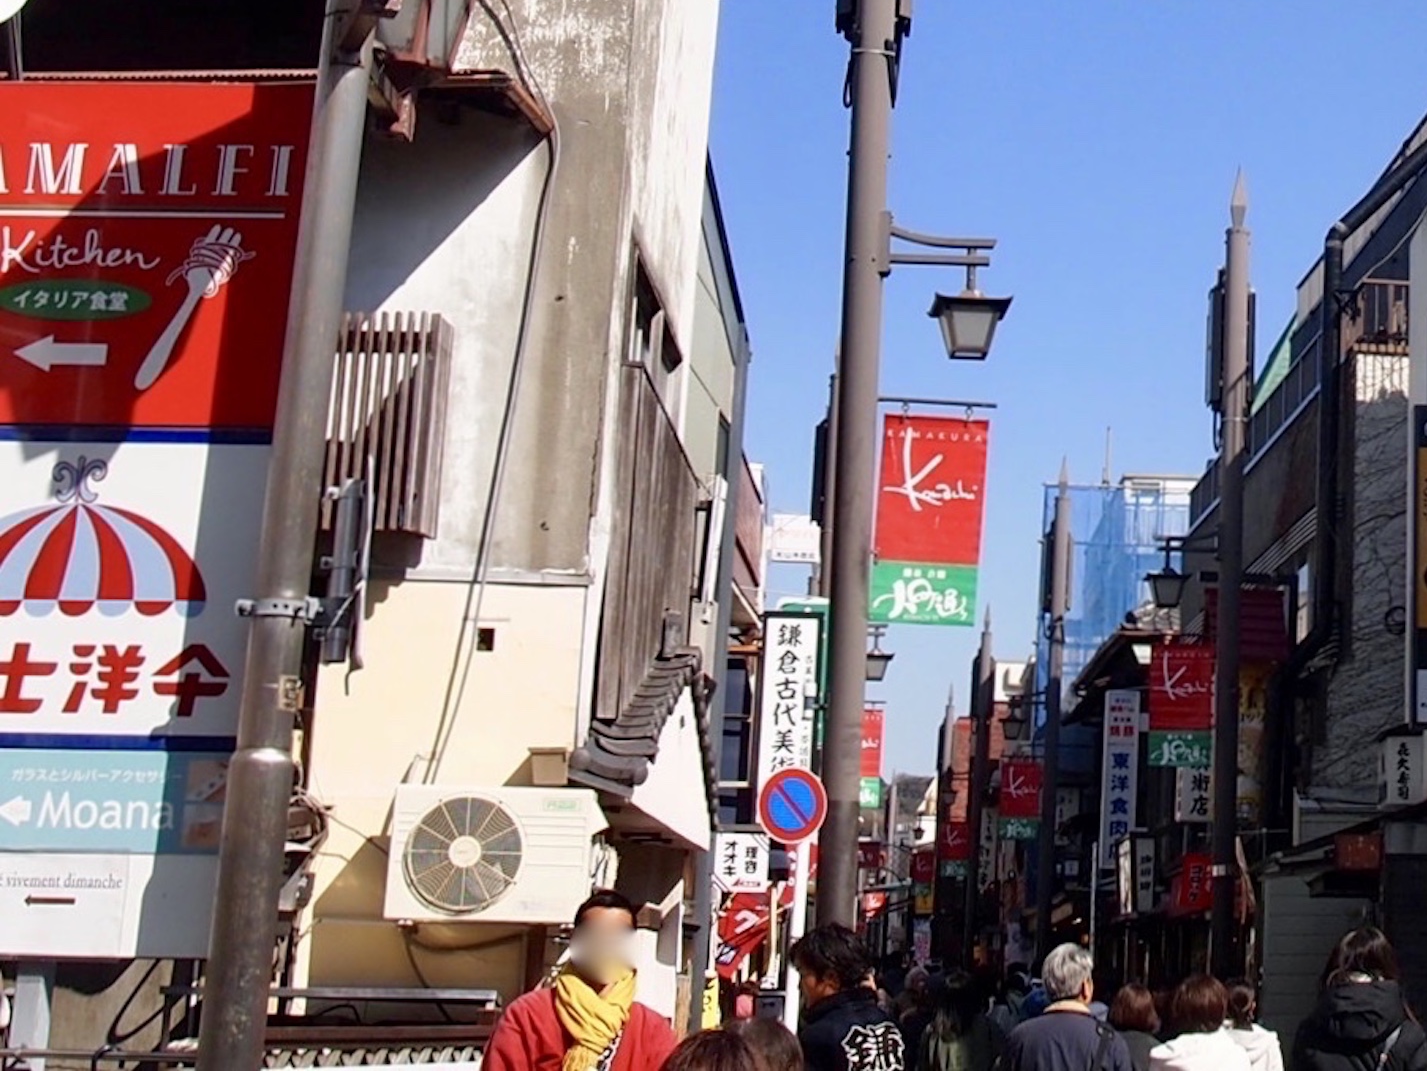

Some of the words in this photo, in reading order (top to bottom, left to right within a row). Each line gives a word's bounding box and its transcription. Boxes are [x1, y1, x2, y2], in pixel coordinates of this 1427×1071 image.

[1, 226, 160, 274] Kitchen
[13, 290, 129, 311] イタリア食堂
[11, 768, 183, 782] ガラスとシルバーアクセサリー
[36, 790, 175, 829] Moana
[723, 840, 737, 877] オオキ
[6, 872, 61, 888] vivement
[63, 873, 123, 888] dimanche
